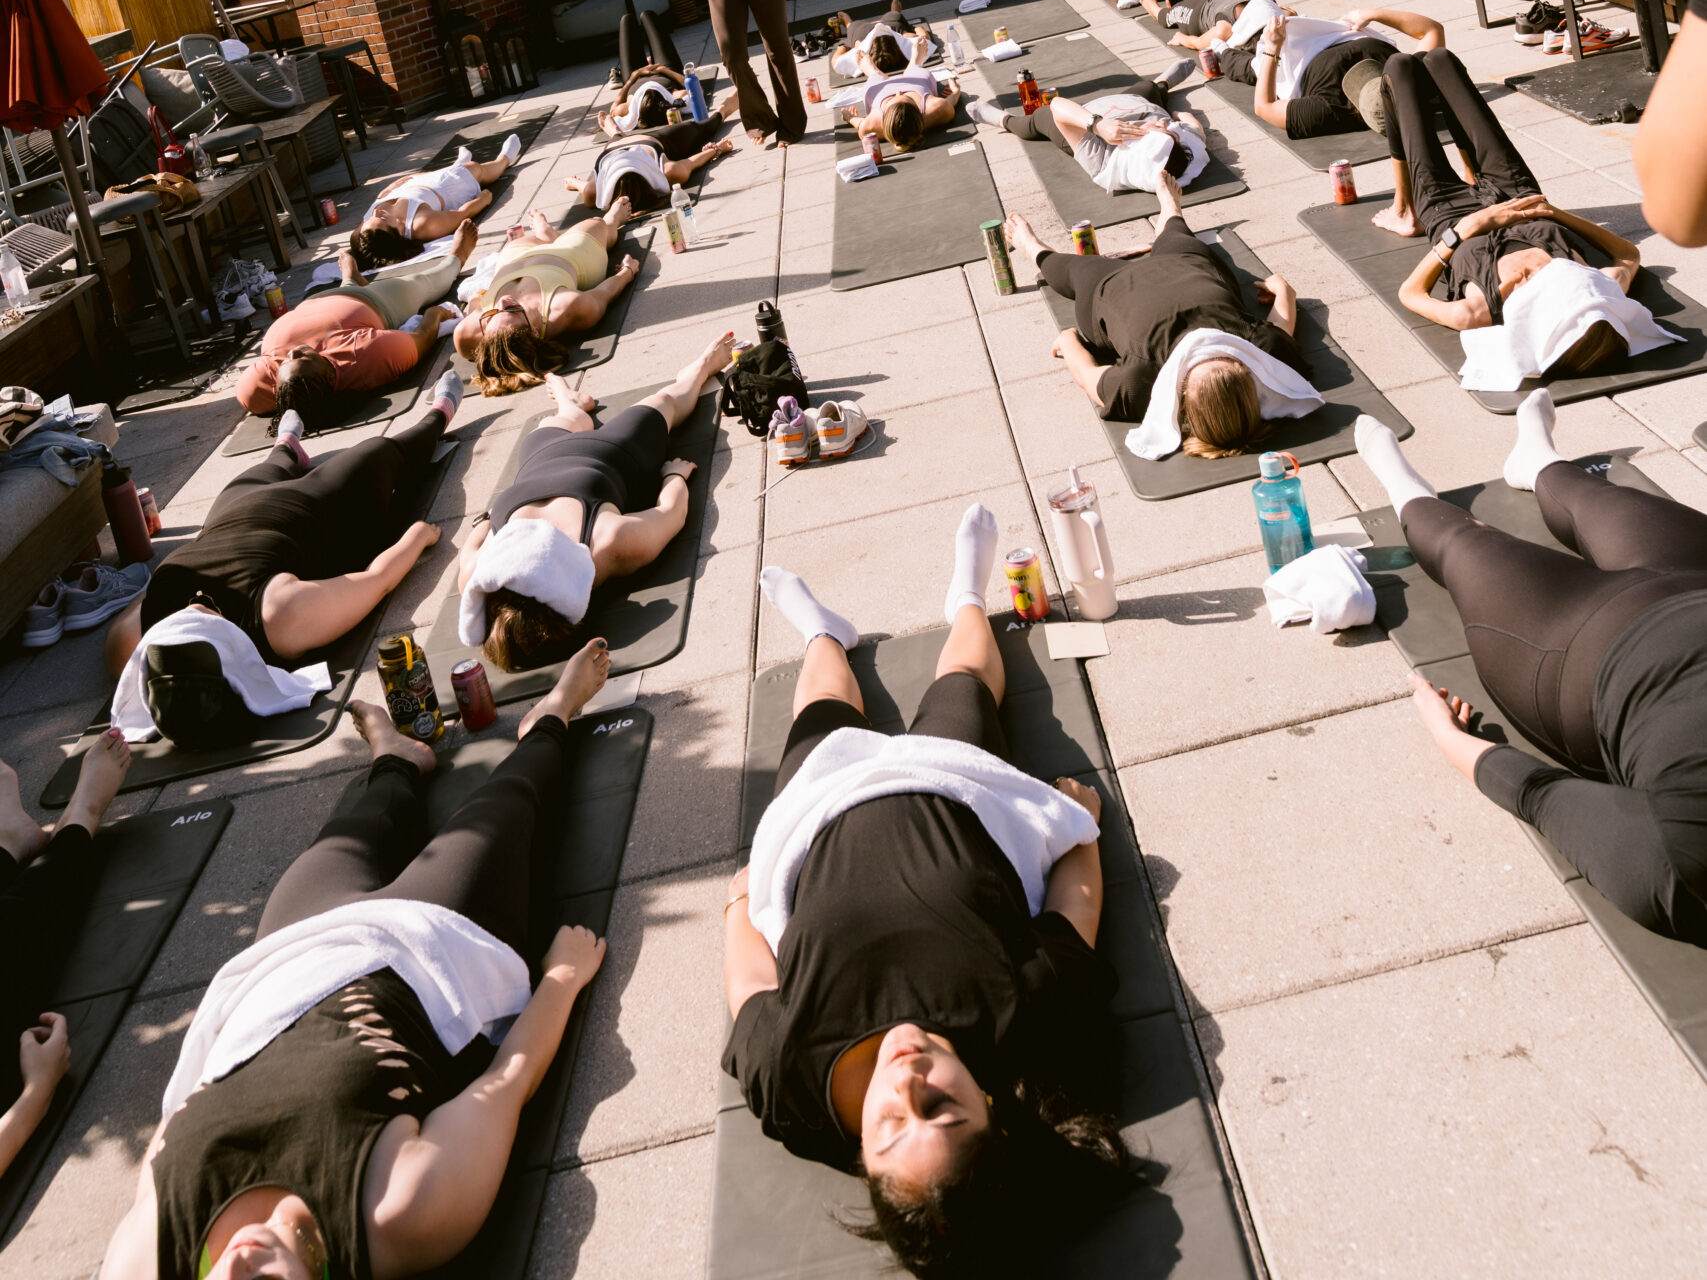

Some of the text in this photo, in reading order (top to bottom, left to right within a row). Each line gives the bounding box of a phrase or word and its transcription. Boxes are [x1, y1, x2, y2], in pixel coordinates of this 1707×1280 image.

[1585, 463, 1612, 474] rlo
[592, 719, 634, 735] Arlo
[170, 811, 213, 827] Arlo
